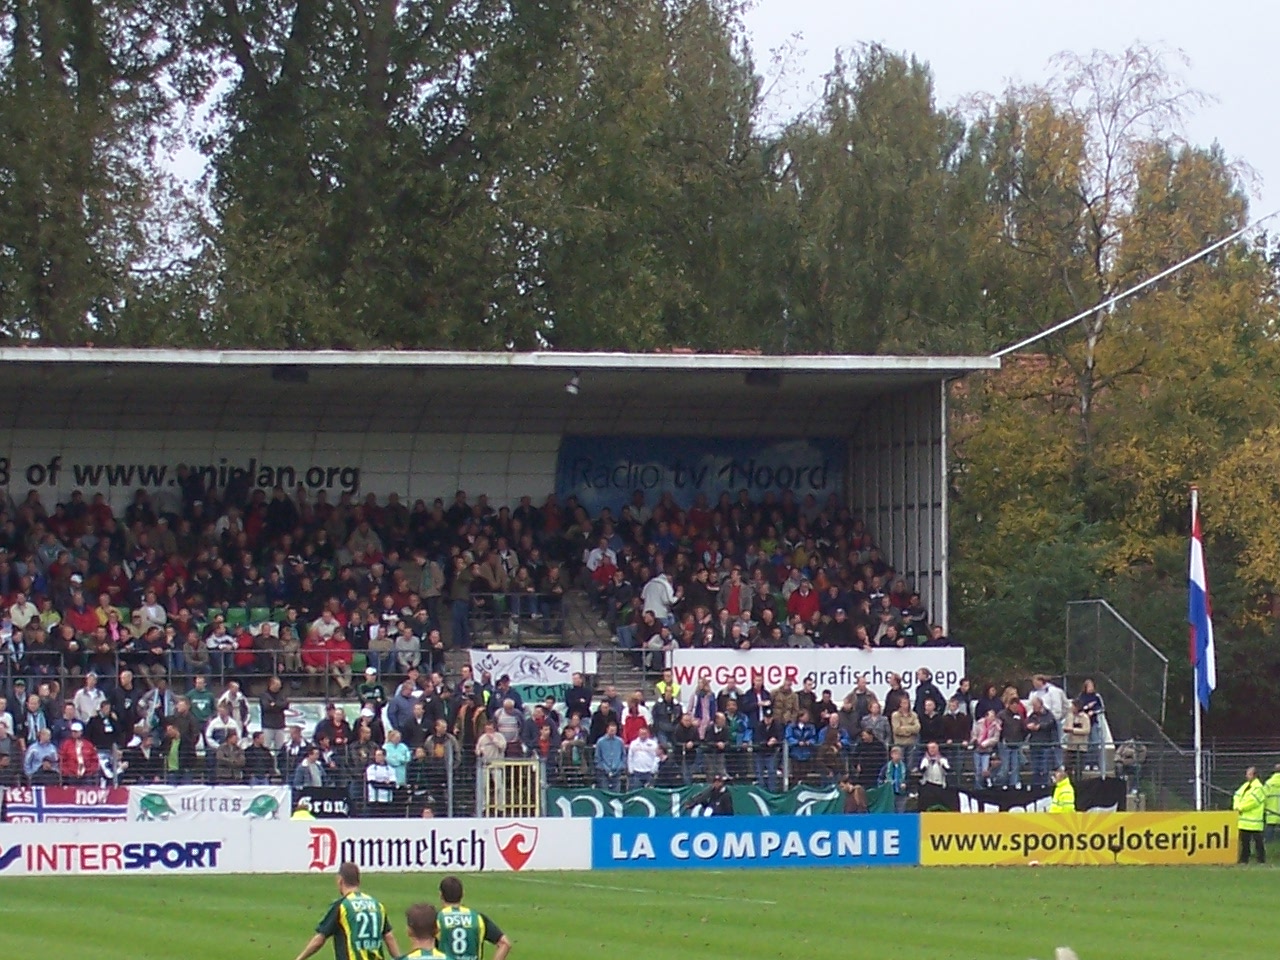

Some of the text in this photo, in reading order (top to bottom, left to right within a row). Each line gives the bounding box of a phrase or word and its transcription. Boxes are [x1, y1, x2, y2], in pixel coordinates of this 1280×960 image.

[26, 456, 62, 487] of
[571, 457, 661, 490] Radio
[717, 457, 829, 490] Noord
[181, 796, 242, 812] ultras
[27, 841, 222, 871] INTERSPORT
[308, 827, 485, 871] Dommelsch
[612, 829, 900, 859] LA COMPAGNIE
[930, 825, 1229, 857] www.sponsorloterij.nl
[351, 900, 377, 911] DSW
[356, 912, 378, 938] 21
[444, 915, 472, 927] DSW
[452, 928, 467, 954] 8
